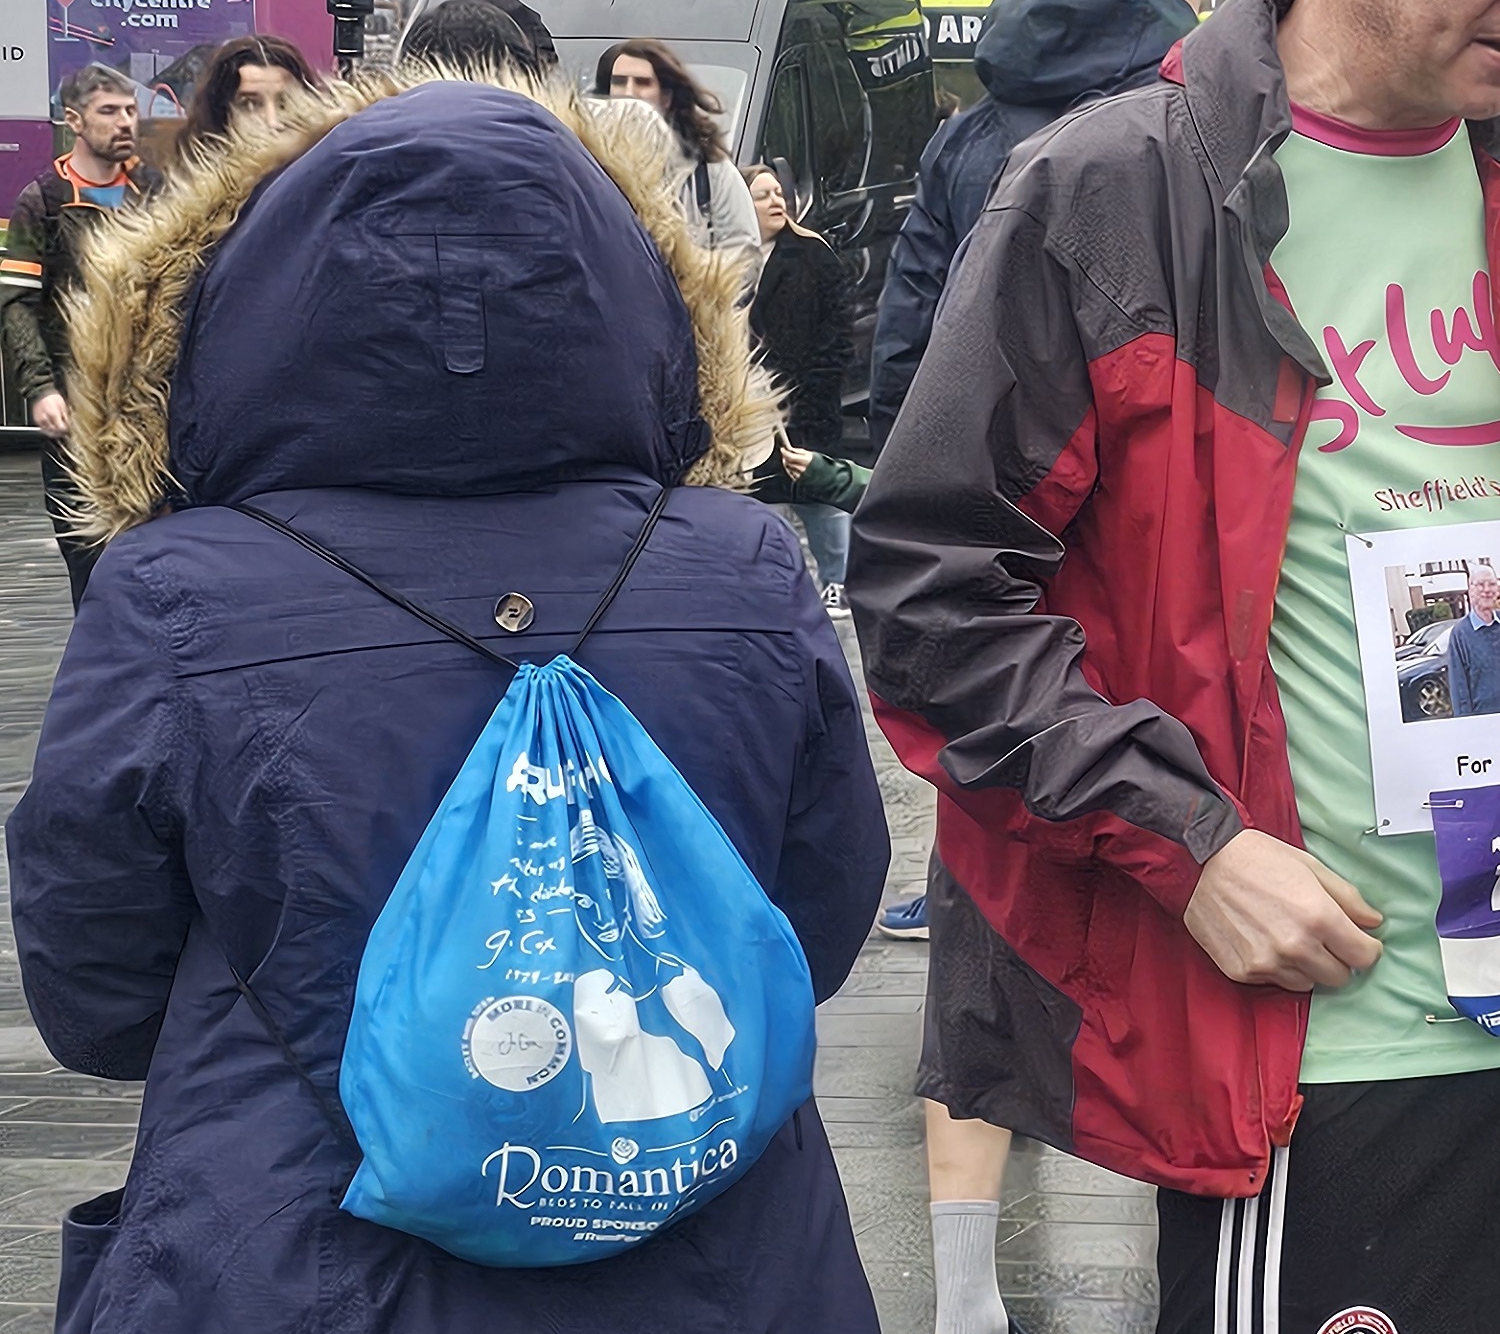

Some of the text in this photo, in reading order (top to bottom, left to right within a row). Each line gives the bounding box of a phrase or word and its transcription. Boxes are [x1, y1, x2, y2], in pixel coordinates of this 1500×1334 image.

[120, 13, 178, 28] .com
[938, 14, 987, 44] AR
[1457, 755, 1492, 777] For
[481, 1138, 738, 1209] Romantica
[530, 1215, 589, 1229] PROUD
